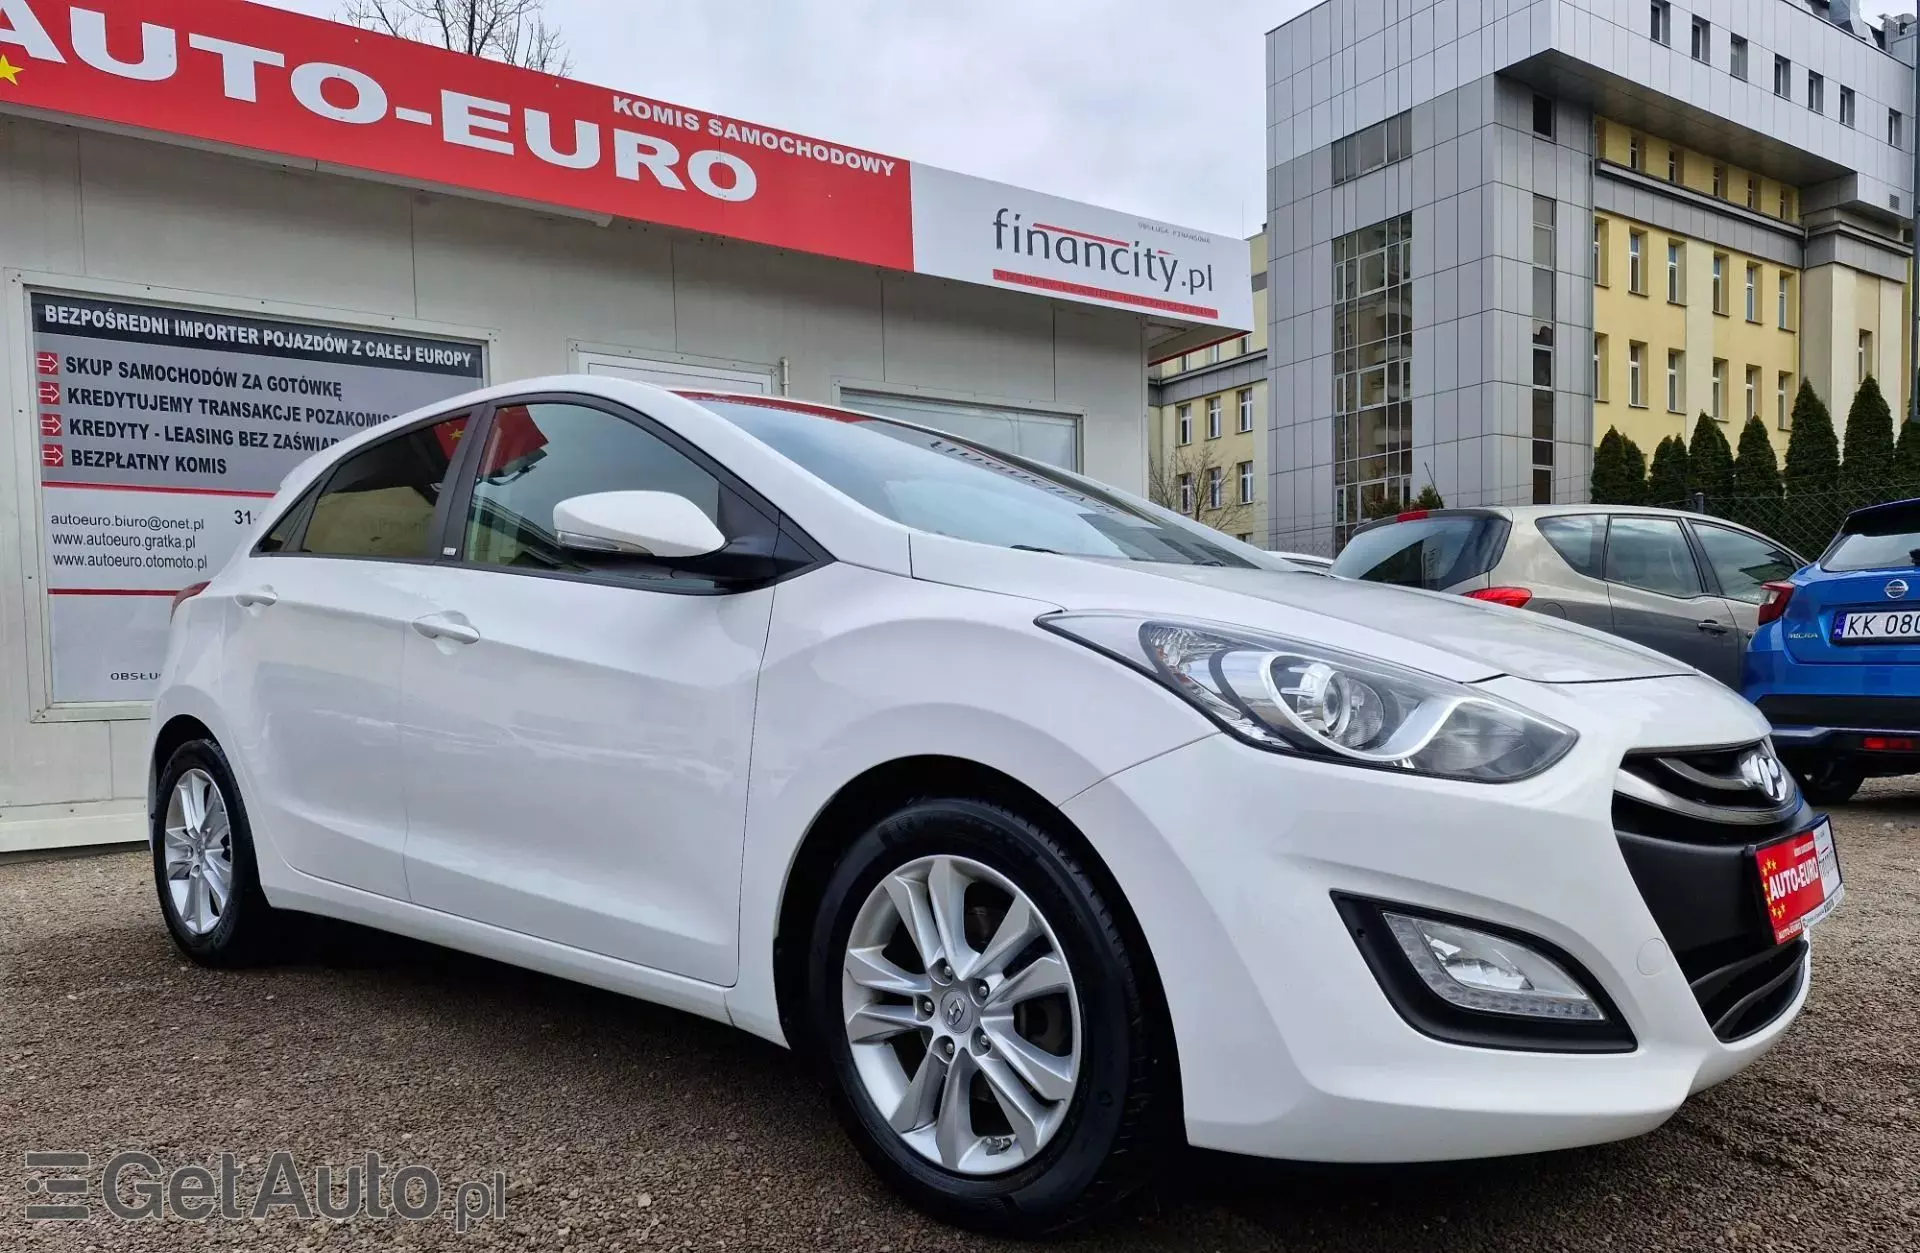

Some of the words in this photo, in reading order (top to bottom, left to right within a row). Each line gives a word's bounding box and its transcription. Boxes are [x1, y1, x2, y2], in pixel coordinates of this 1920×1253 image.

[613, 95, 700, 132] KOMIS
[708, 117, 895, 177] SAMOCHODOWY
[993, 207, 1213, 295] financity.pl
[44, 304, 169, 336] BEZPOŚREDNI
[174, 318, 259, 346] IMPORTER
[263, 328, 348, 354] POJAZDÓW
[351, 339, 362, 356] Z
[365, 340, 412, 362] CAŁEJ
[415, 346, 472, 368] EUROPY
[65, 356, 113, 377] SKUP
[118, 361, 238, 388] SAMOCHODÓW
[242, 373, 263, 391] ZA
[266, 374, 343, 401] GOTÓWKĘ
[67, 386, 194, 414] KREDYTUJEMY
[198, 398, 301, 423] TRANSAKCJE
[305, 407, 398, 427] POZAKOMI
[69, 418, 150, 441] KREDYTY
[164, 425, 234, 446] LEASING
[238, 430, 269, 449] BEZ
[71, 449, 170, 472] BEZPŁATNY
[175, 455, 227, 475] KOMIS
[51, 513, 204, 531] autoeuro.biuro@onet.pl
[52, 532, 196, 551] www.autoeuro.gratka.pl
[53, 553, 208, 572] www.autoeuro.otomoto.pl
[1847, 614, 1877, 635] KK
[110, 672, 161, 681] OBSŁU
[1769, 856, 1820, 901] AUTO-EURO
